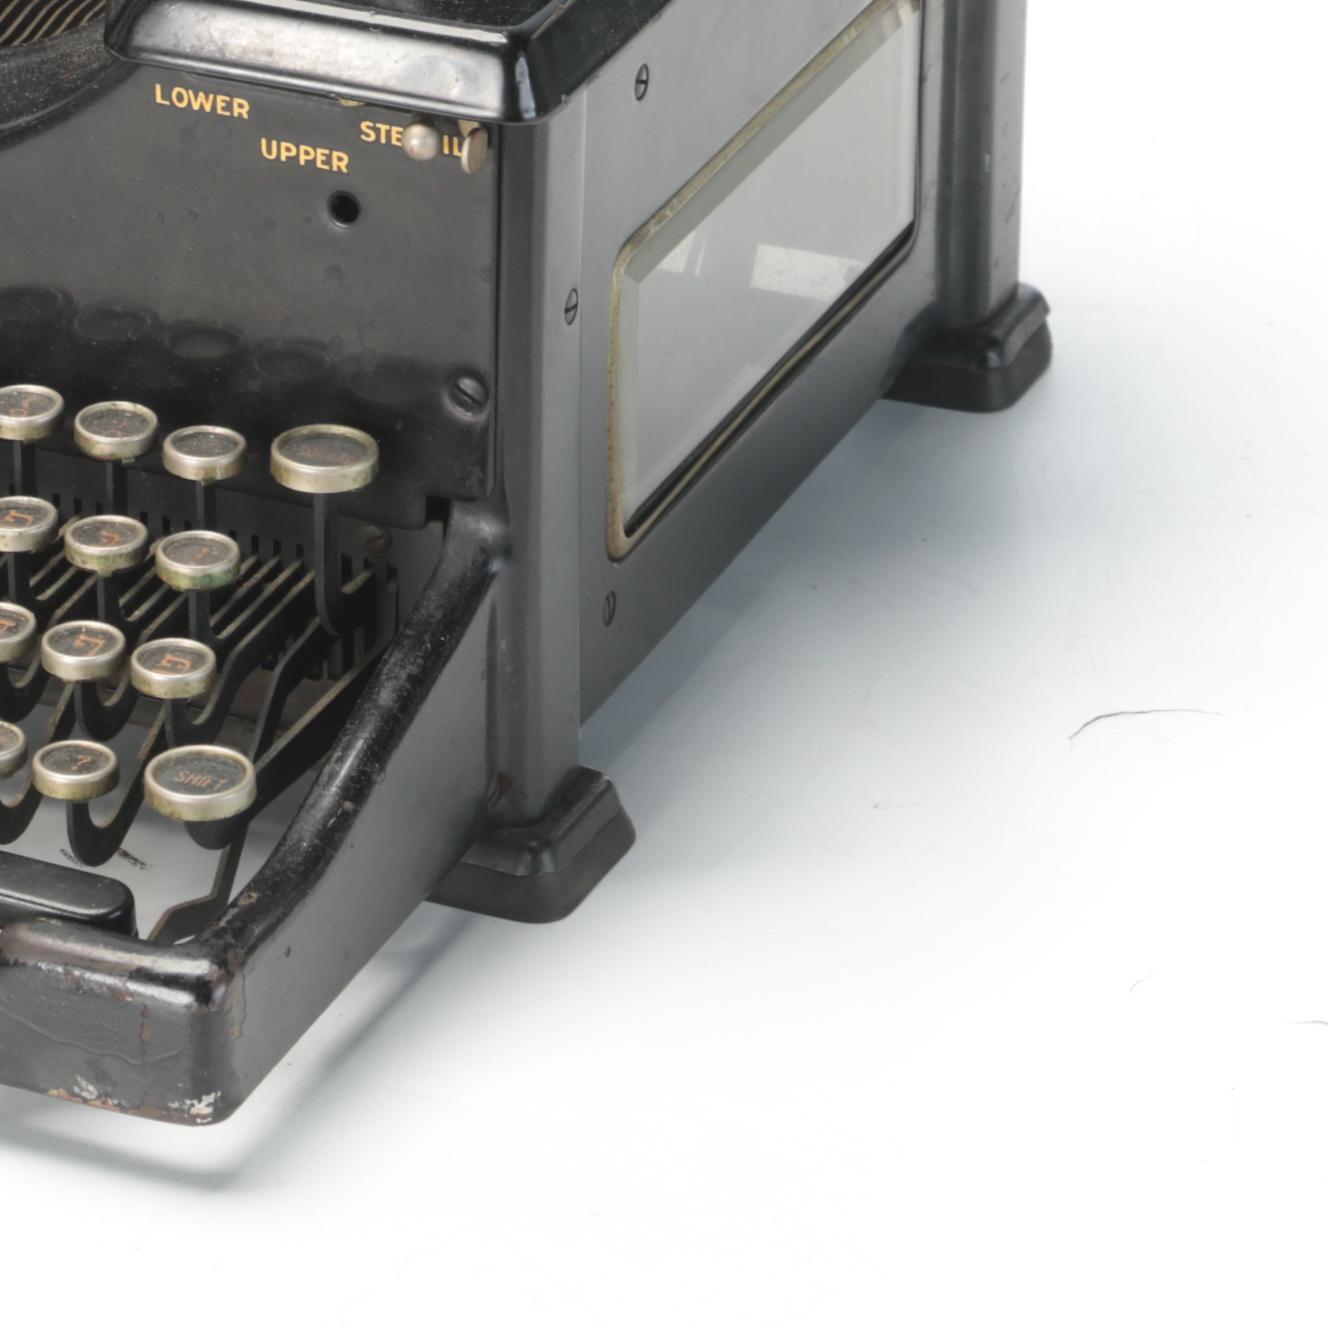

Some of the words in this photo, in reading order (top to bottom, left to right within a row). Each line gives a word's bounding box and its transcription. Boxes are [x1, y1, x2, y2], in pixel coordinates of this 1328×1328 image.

[154, 83, 250, 120] LOWER
[260, 137, 350, 173] UPPER
[359, 120, 464, 158] STEIL
